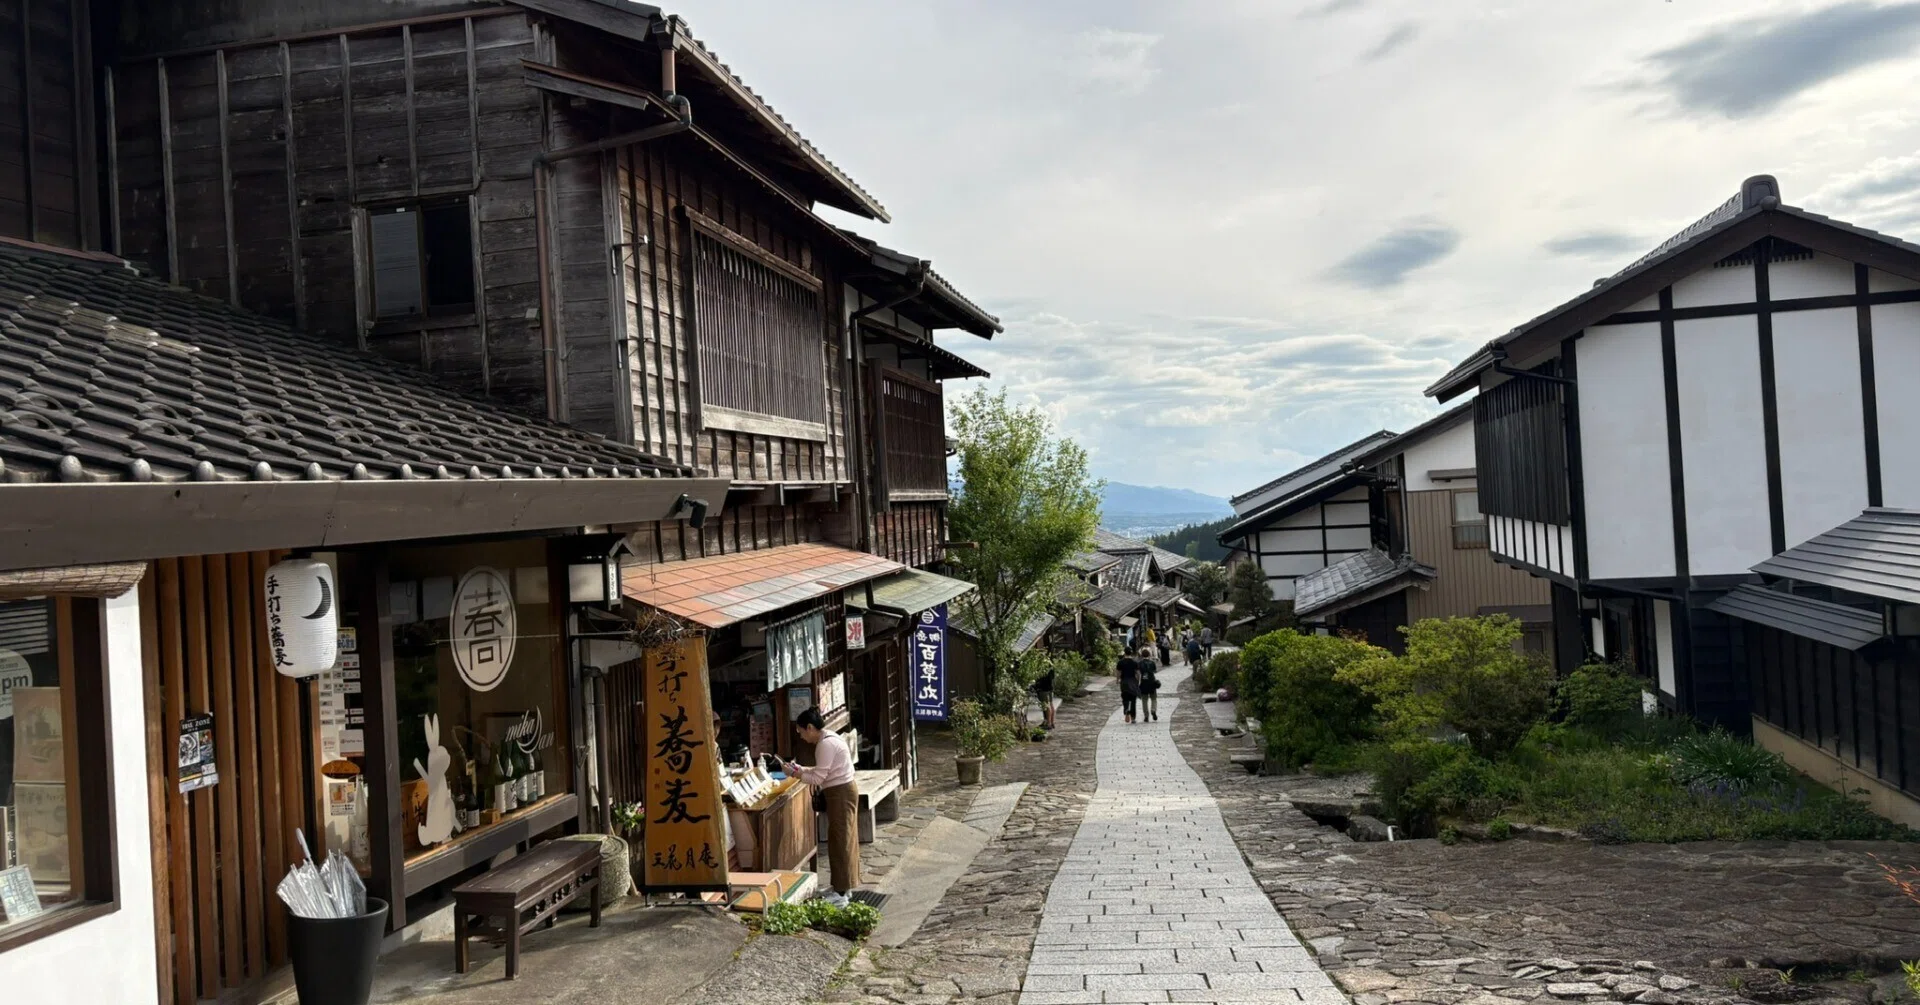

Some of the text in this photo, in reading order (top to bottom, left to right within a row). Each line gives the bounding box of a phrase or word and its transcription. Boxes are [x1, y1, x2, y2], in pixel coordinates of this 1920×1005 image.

[267, 574, 294, 667] 手打ち蕎麦
